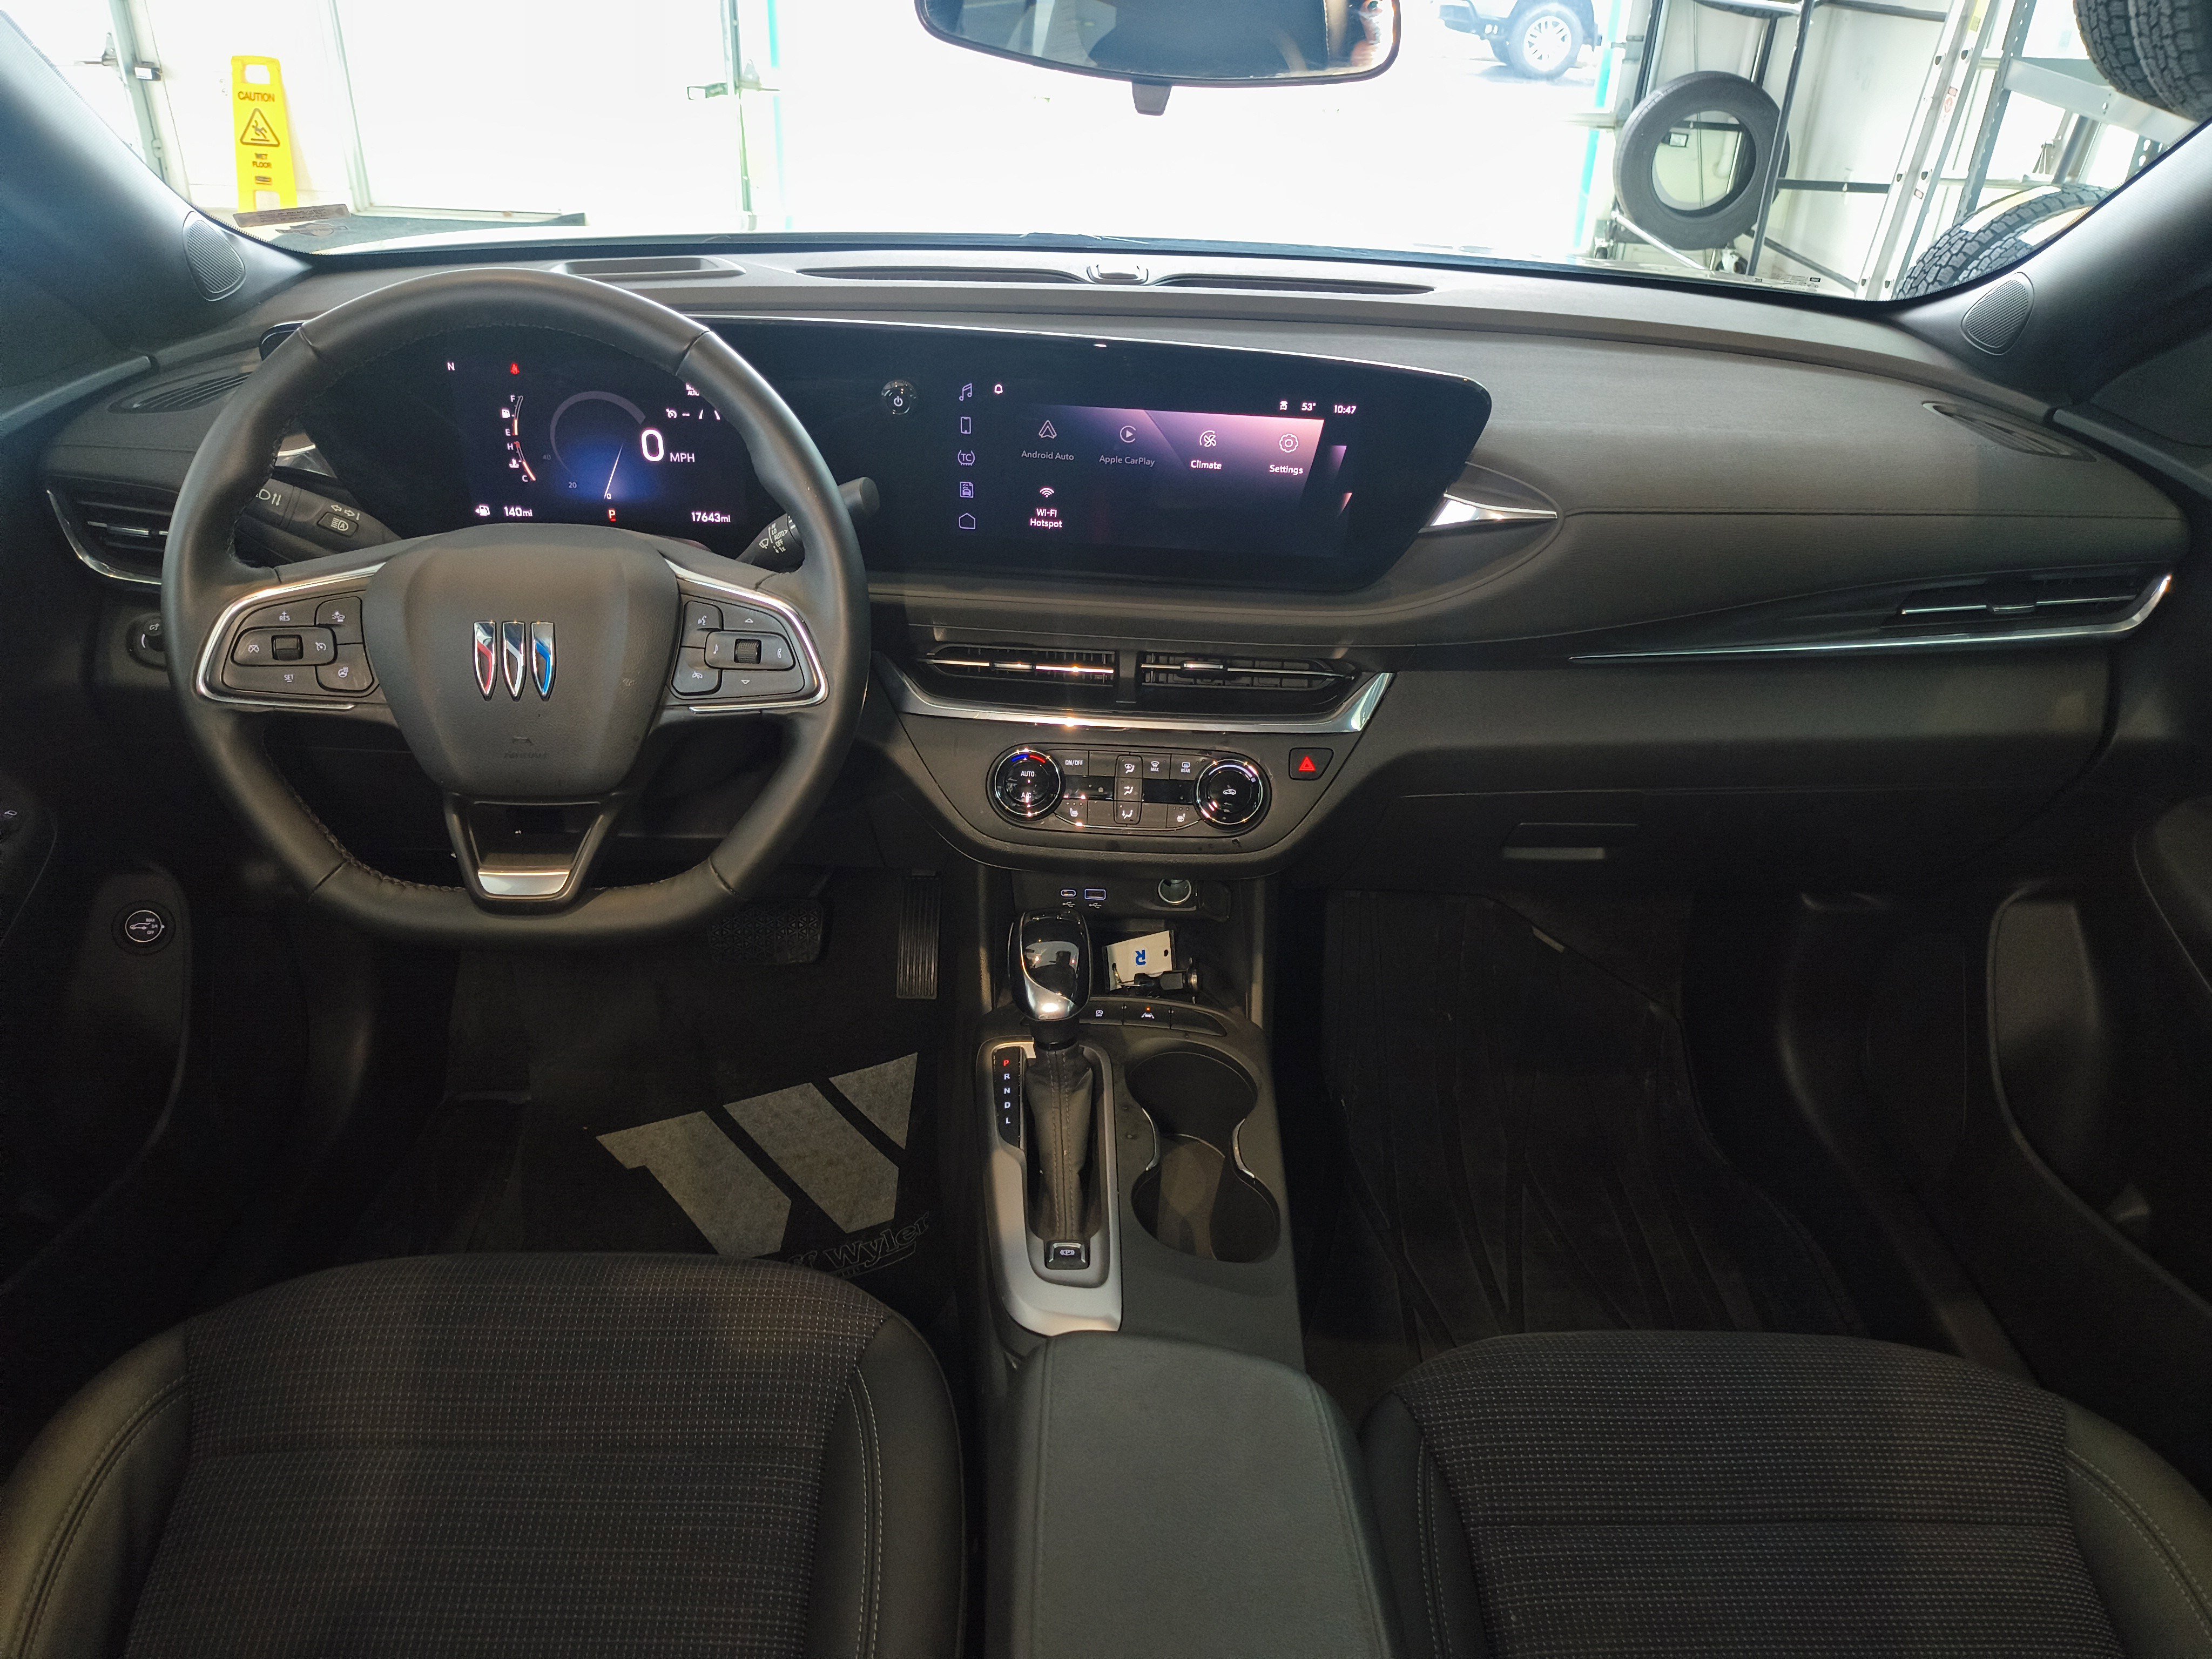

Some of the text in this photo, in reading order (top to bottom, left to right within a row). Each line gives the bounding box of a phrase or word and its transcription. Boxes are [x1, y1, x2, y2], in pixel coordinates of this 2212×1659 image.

[238, 91, 275, 102] CAUTION
[448, 362, 455, 371] N
[1333, 404, 1357, 414] 10:47
[640, 428, 664, 462] 0
[670, 453, 695, 463] MPH
[1021, 450, 1074, 461] Android Auto
[1099, 455, 1155, 467] Apple CarPlay
[1190, 460, 1222, 470] Climate
[1269, 464, 1303, 476] Settings
[609, 509, 616, 519] P
[1036, 508, 1057, 517] Wi-Fi
[1030, 518, 1063, 529] Hotspot
[774, 530, 785, 541] AUTO
[823, 1211, 929, 1269] Wyler
